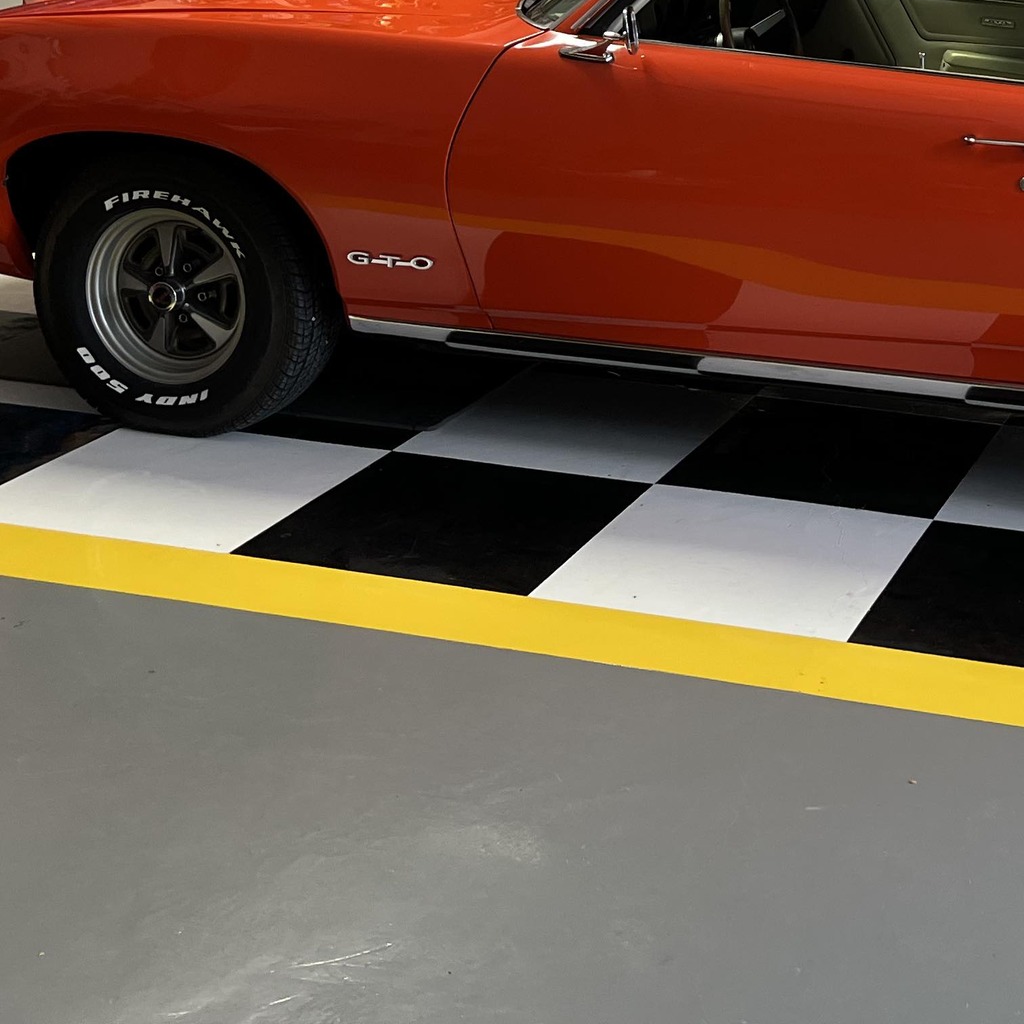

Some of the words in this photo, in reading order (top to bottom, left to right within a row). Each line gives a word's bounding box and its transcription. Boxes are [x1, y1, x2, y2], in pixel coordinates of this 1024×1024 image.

[104, 190, 246, 259] FIREHAWK
[77, 347, 129, 394] 500
[135, 389, 209, 406] INDY
